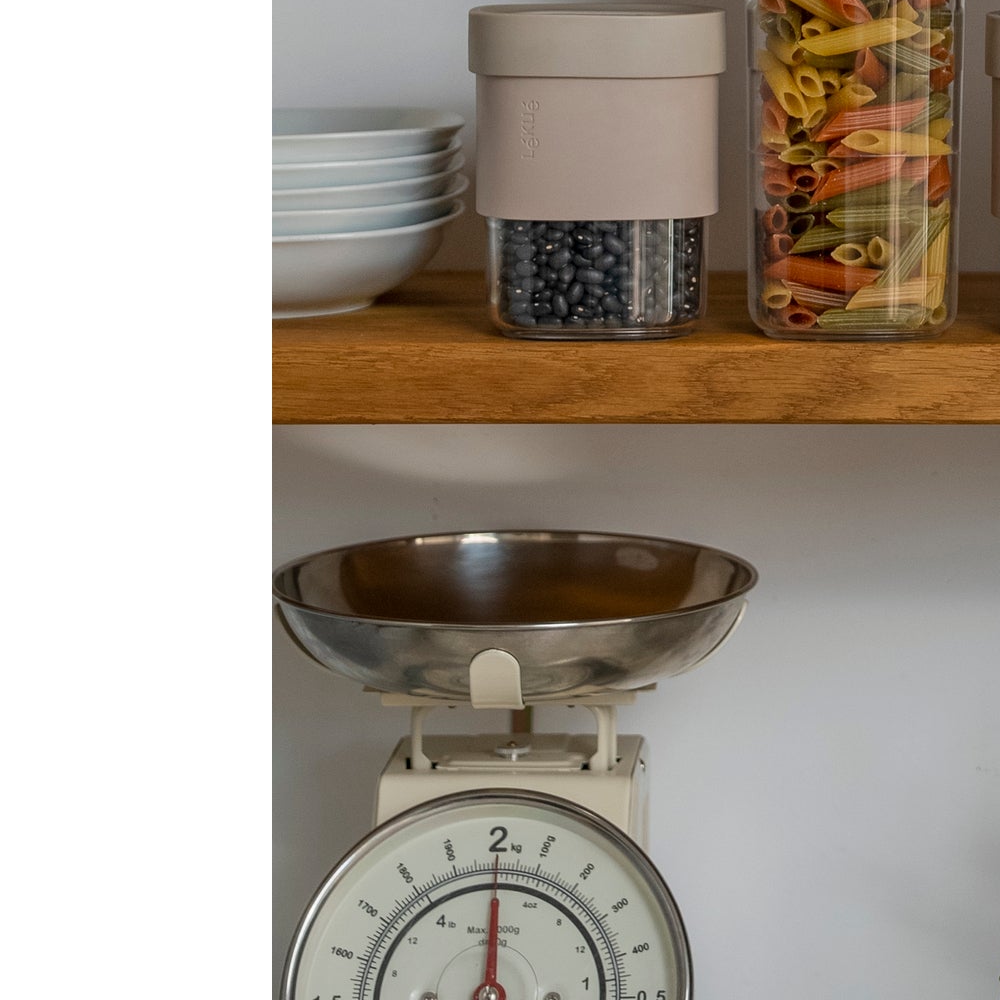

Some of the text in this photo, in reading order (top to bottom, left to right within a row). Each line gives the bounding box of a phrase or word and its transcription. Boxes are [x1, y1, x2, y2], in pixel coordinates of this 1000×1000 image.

[488, 826, 523, 854] 2 kg
[539, 835, 557, 858] 100g
[443, 838, 456, 862] 1900
[396, 862, 414, 884] 1800
[579, 863, 595, 880] 200
[357, 899, 378, 918] 1700
[522, 901, 538, 909] 4oz
[611, 897, 629, 913] 300
[436, 914, 446, 928] 4
[556, 918, 562, 926] 8
[408, 936, 418, 945] 12
[331, 946, 354, 960] 1600
[632, 942, 650, 954] 400
[391, 970, 398, 978] 8
[582, 977, 589, 991] 1
